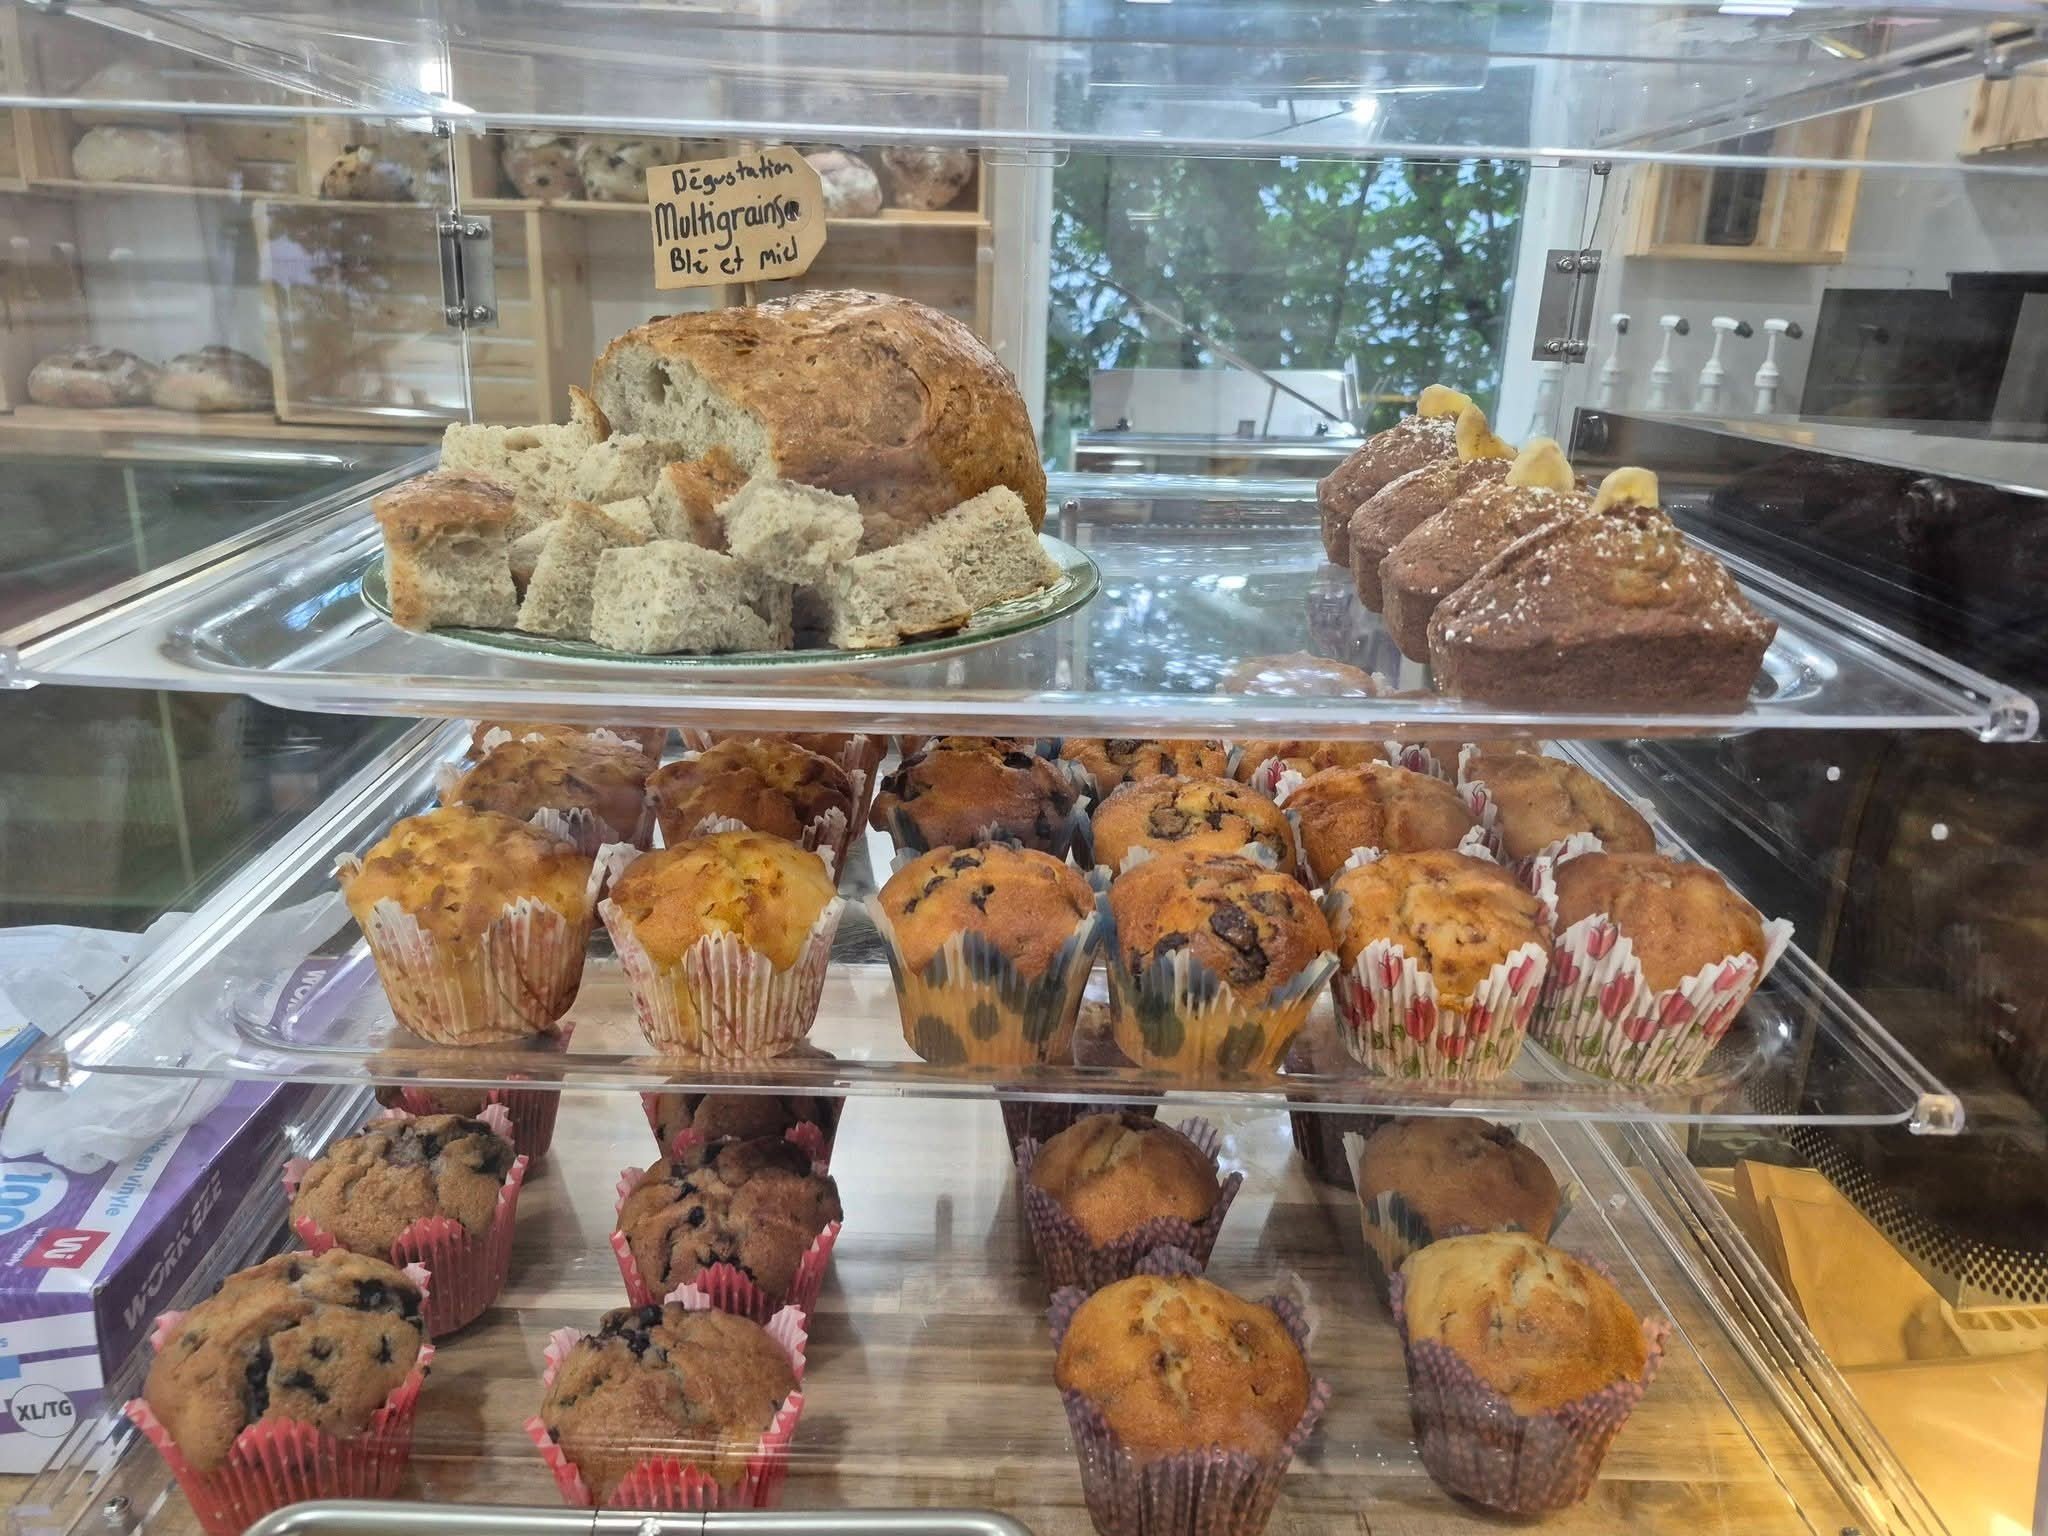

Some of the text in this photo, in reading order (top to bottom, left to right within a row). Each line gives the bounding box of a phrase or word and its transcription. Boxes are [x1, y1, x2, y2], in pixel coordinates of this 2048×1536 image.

[672, 155, 793, 195] Dégustation
[655, 194, 786, 250] Multigrains
[670, 246, 708, 274] Blé
[720, 246, 744, 275] et
[105, 1174, 145, 1217] vinyle
[16, 1399, 73, 1422] XL/TG
